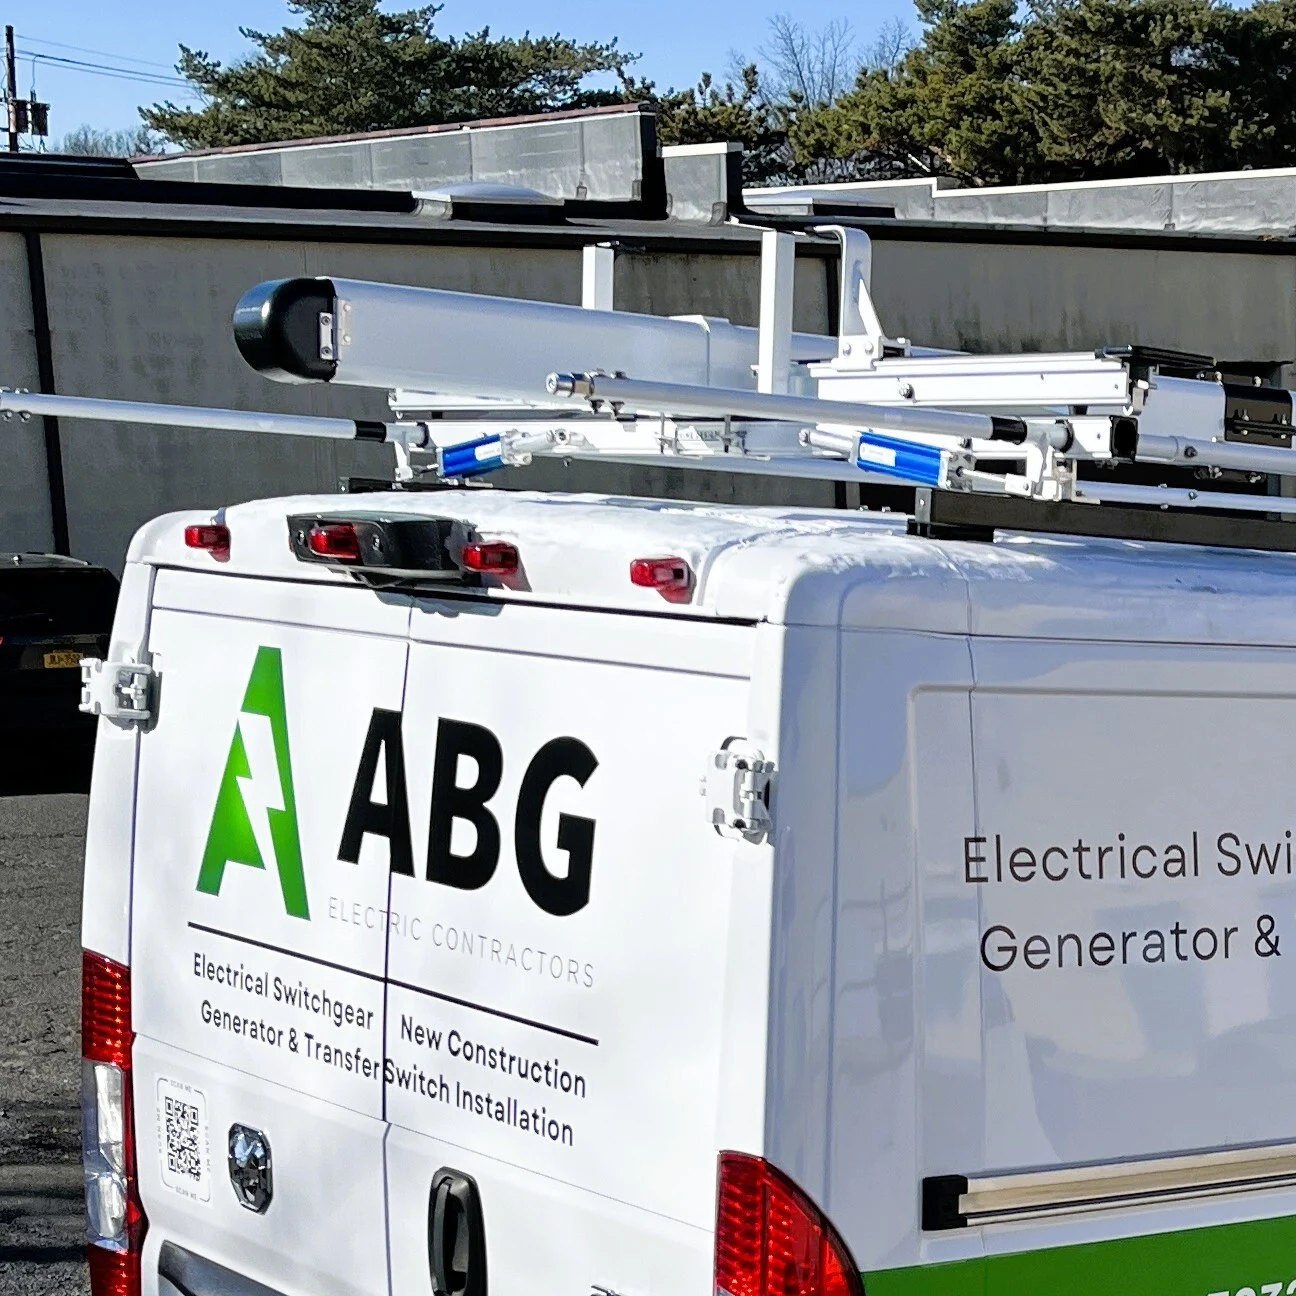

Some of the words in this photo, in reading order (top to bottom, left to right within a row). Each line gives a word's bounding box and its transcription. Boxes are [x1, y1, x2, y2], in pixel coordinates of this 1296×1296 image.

[337, 708, 599, 917] ABG
[964, 831, 1200, 883] Electrical
[328, 897, 421, 941] ELECTRIC
[432, 923, 594, 988] CONTRACTORS
[980, 921, 1239, 972] Generator
[1254, 914, 1282, 958] &
[193, 952, 268, 998] Electrical
[273, 977, 374, 1030] Switchgear
[400, 1014, 442, 1051] New
[447, 1030, 587, 1098] Construction
[201, 1000, 283, 1048] Generator
[288, 1027, 299, 1052] &
[305, 1033, 381, 1080] Transfer
[383, 1057, 450, 1104] Switch
[456, 1081, 574, 1147] Installation
